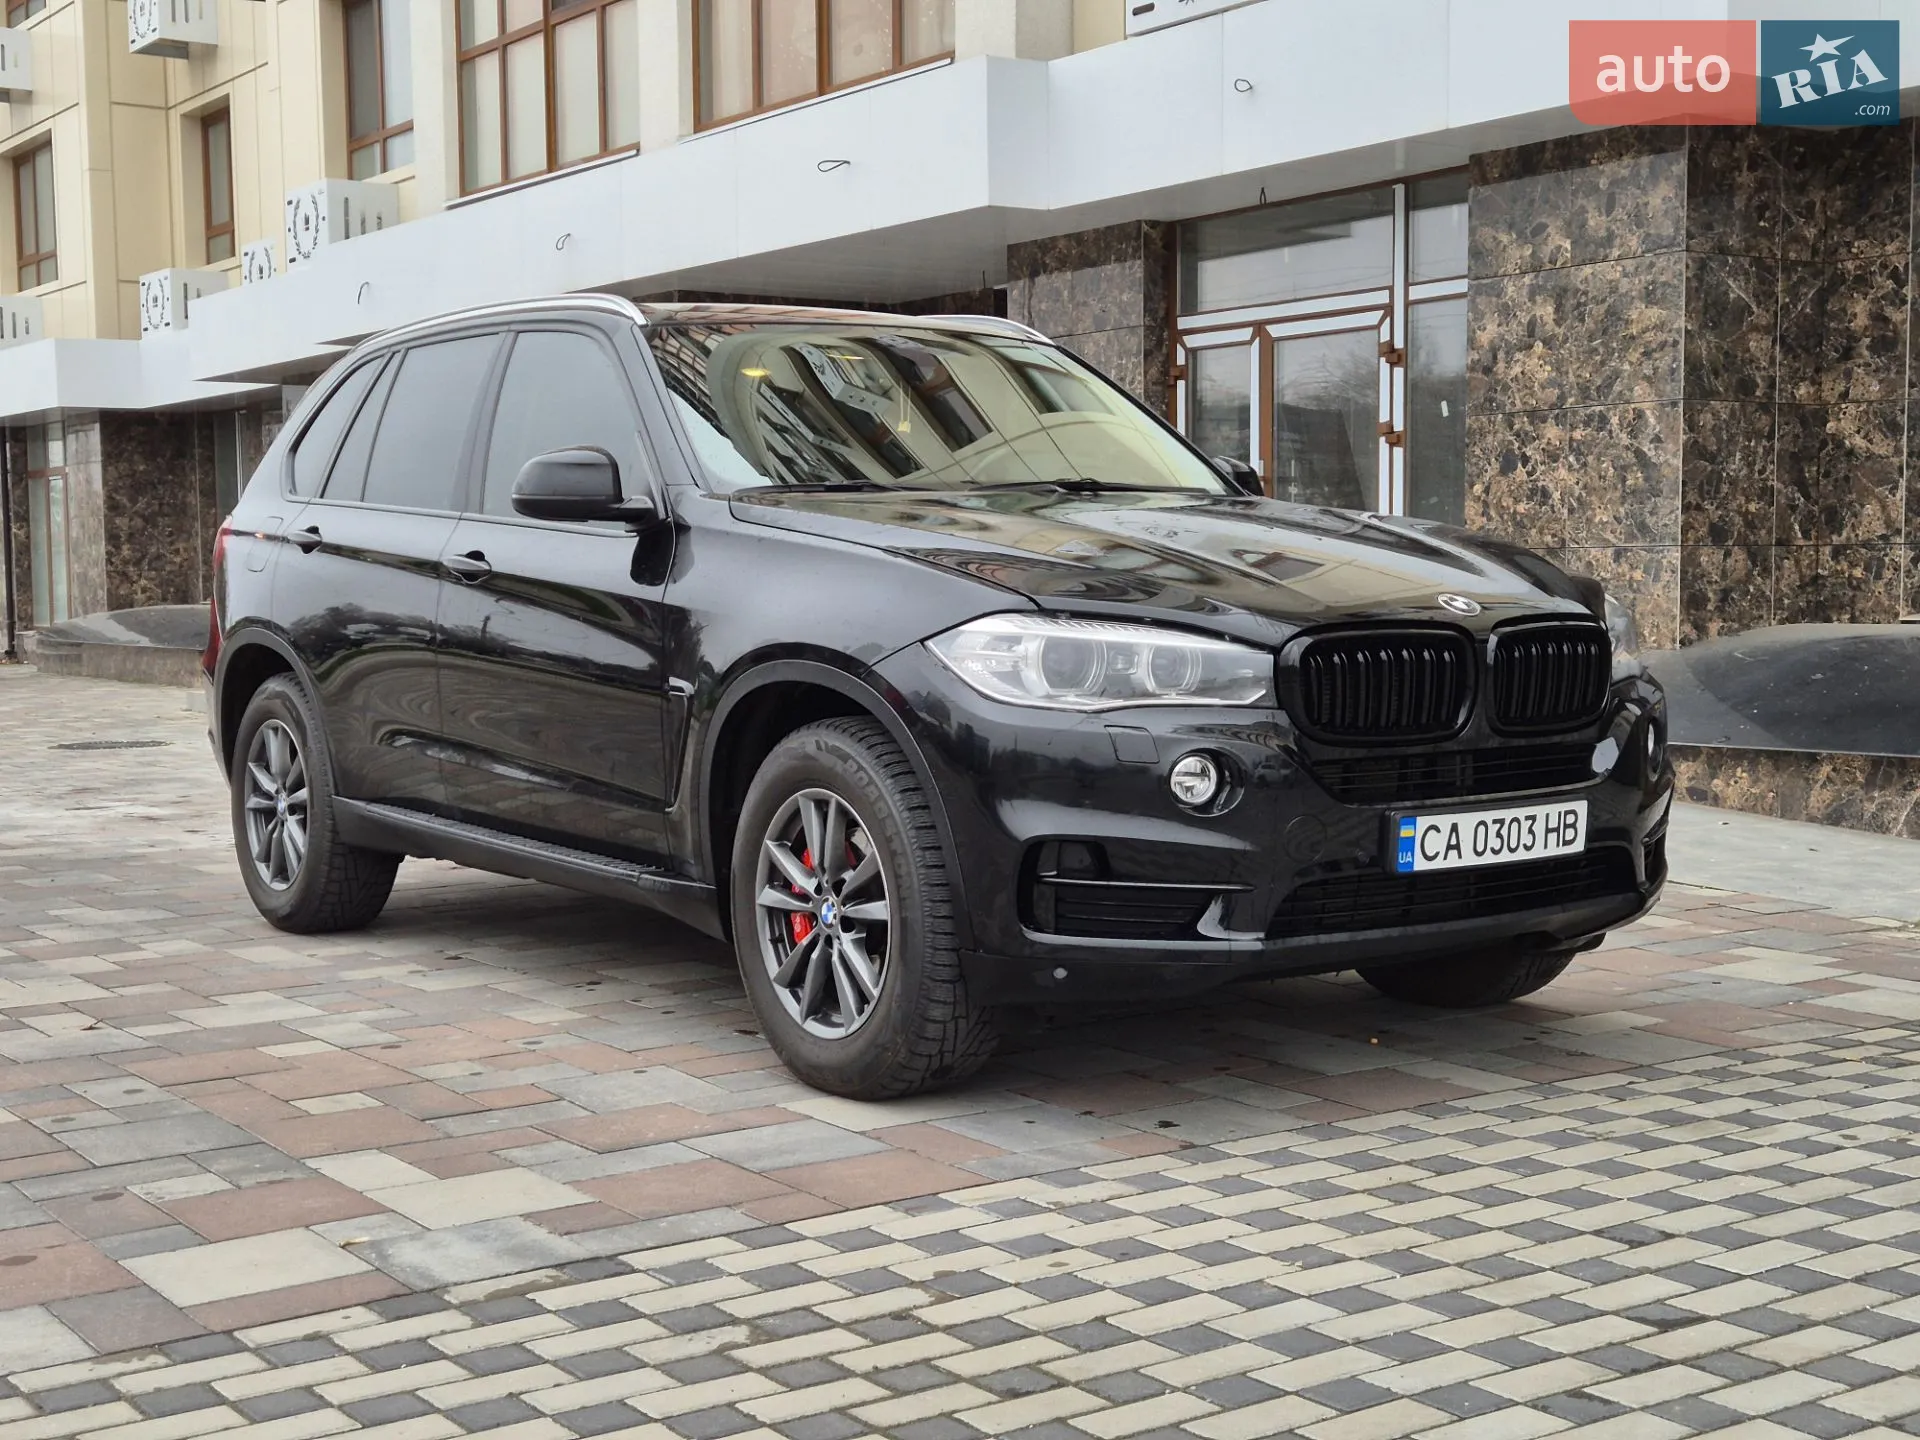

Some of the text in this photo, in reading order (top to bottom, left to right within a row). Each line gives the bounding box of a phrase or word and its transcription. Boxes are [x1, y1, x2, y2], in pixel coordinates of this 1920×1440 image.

[1420, 809, 1578, 862] CA 0303 HB
[1399, 851, 1413, 863] UA
